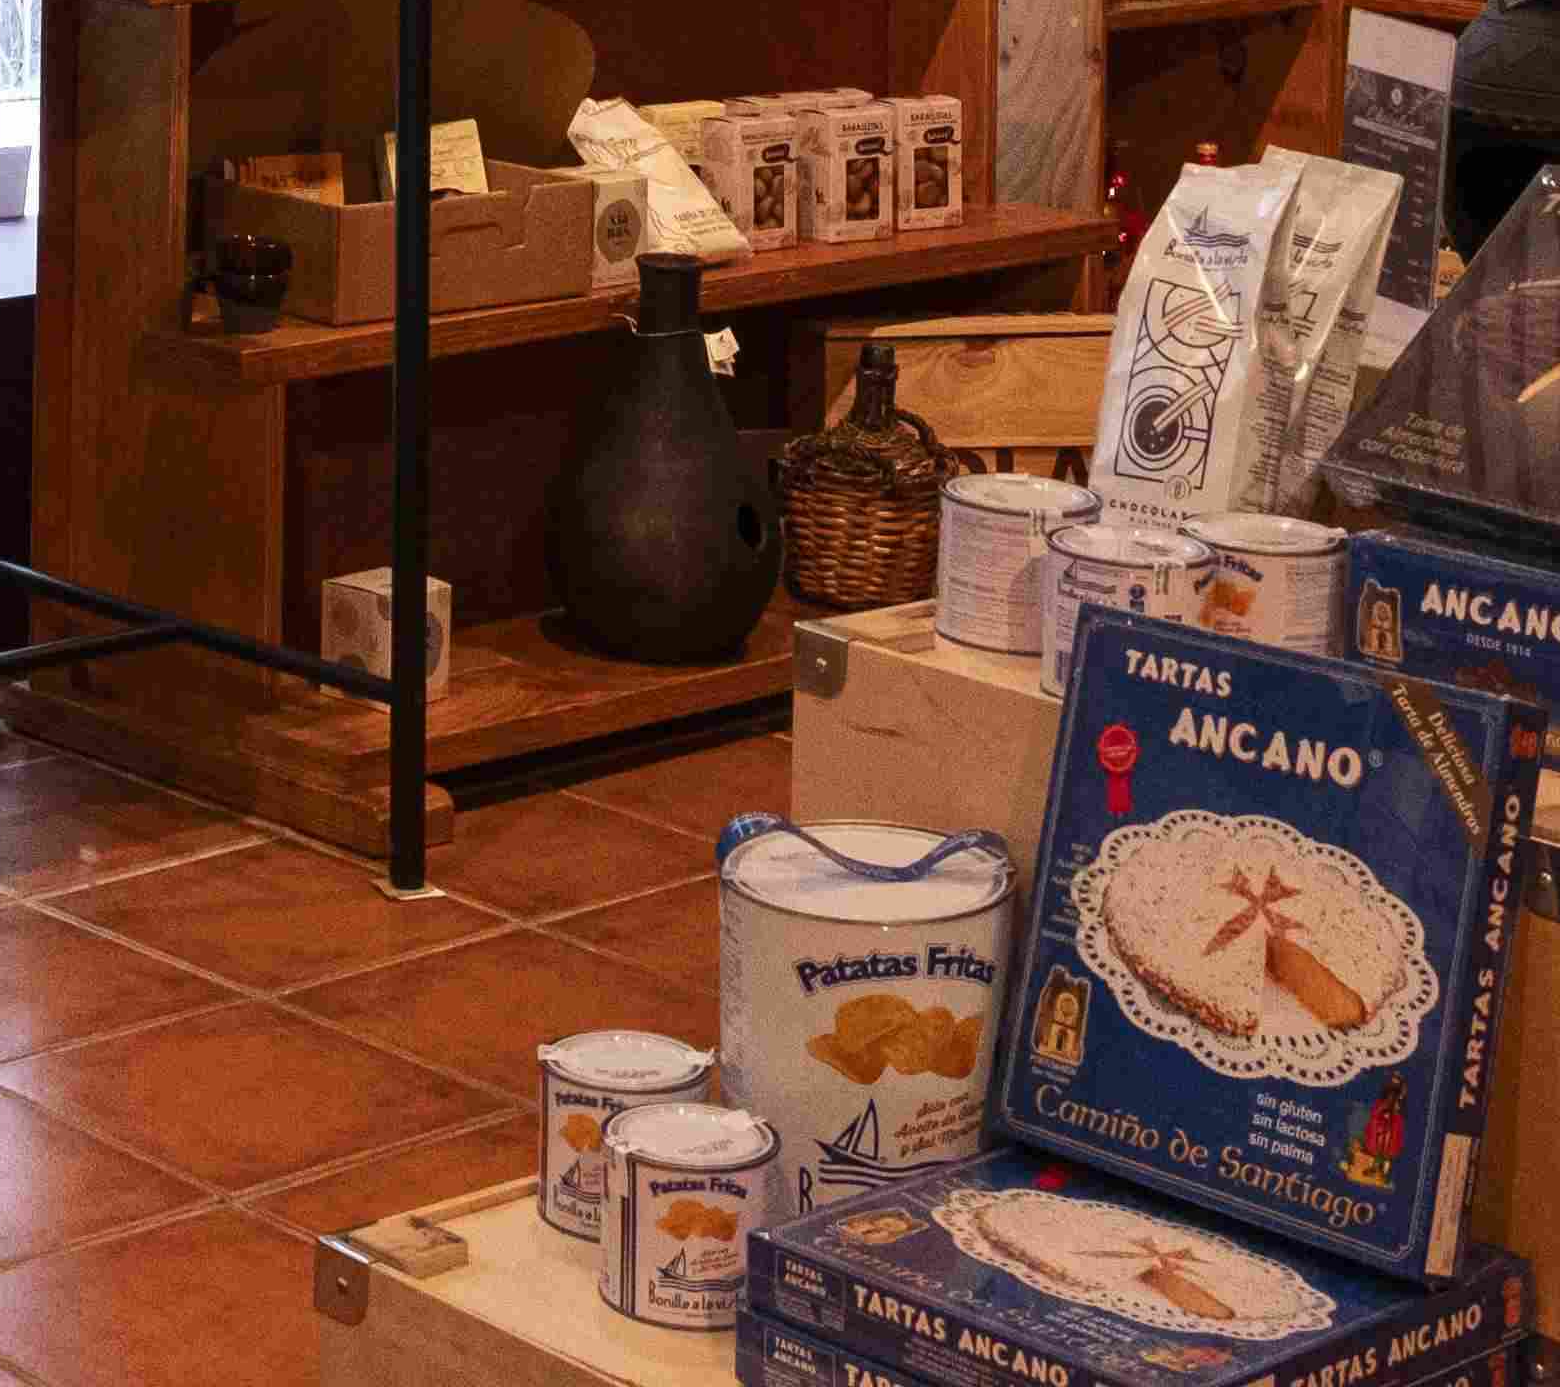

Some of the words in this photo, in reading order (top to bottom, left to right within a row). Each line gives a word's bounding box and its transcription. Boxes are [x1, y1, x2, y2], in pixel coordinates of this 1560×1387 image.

[1466, 634, 1500, 652] DESDE
[1506, 642, 1533, 659] 1914
[1125, 649, 1232, 699] TARTAS
[1169, 707, 1362, 788] ANCANO
[1417, 730, 1434, 748] de
[1428, 711, 1476, 786] Deliciosa
[795, 952, 917, 997] Patatas
[927, 943, 995, 984] Fritas
[1458, 968, 1495, 1110] TARTAS
[1483, 794, 1522, 953] ANCANO
[1251, 1111, 1274, 1129] sin
[1276, 1115, 1327, 1147] lactosa
[1256, 1092, 1278, 1110] sin
[1280, 1098, 1323, 1124] gluten
[1034, 1082, 1161, 1154] Camiño
[1169, 1130, 1209, 1169] de
[1218, 1146, 1375, 1228] Santiago
[1247, 1131, 1270, 1149] sin
[1272, 1136, 1315, 1165] palma
[647, 1179, 706, 1197] Patatas
[708, 1176, 748, 1199] Fritas
[853, 1283, 946, 1343] TARTAS
[957, 1328, 1069, 1387] ANCANO
[1387, 1303, 1482, 1367] ANCANO
